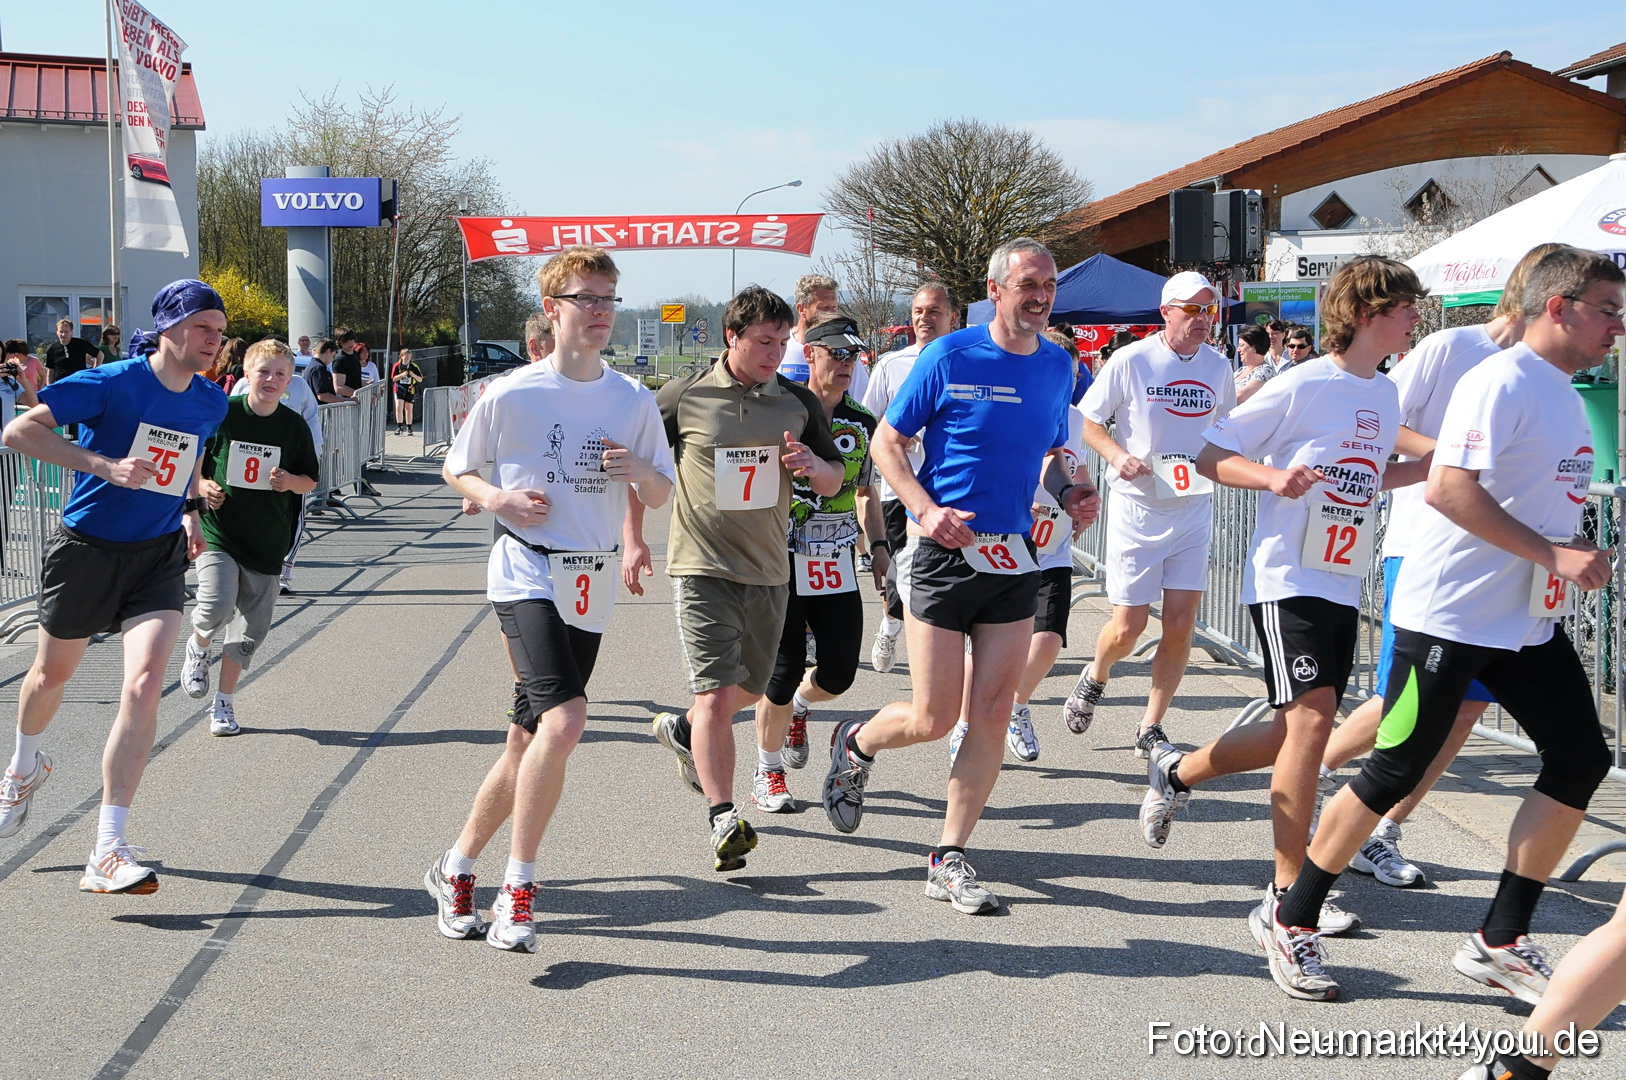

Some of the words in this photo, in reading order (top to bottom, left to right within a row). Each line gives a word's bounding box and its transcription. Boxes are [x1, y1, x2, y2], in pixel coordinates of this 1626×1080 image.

[128, 115, 144, 127] DEN
[272, 192, 364, 210] VOLVO
[1298, 255, 1340, 277] Servi
[1442, 261, 1498, 286] Weißbier
[1146, 386, 1205, 398] GERHART
[147, 436, 178, 448] WERBUNG
[149, 428, 180, 442] MEYER
[239, 443, 263, 452] MEYER
[726, 450, 757, 459] MEYER
[1340, 440, 1384, 455] SEAT
[243, 456, 261, 484] 8
[1173, 464, 1190, 490] 9
[546, 471, 560, 484] 9.
[739, 465, 756, 501] 7
[1322, 505, 1352, 516] MEYER
[1321, 513, 1352, 523] WERBUNG
[1323, 524, 1357, 565] 12
[562, 556, 594, 564] MEYER
[978, 544, 1018, 570] 13
[808, 561, 842, 590] 55
[576, 574, 590, 616] 3
[1295, 666, 1316, 677] FCN
